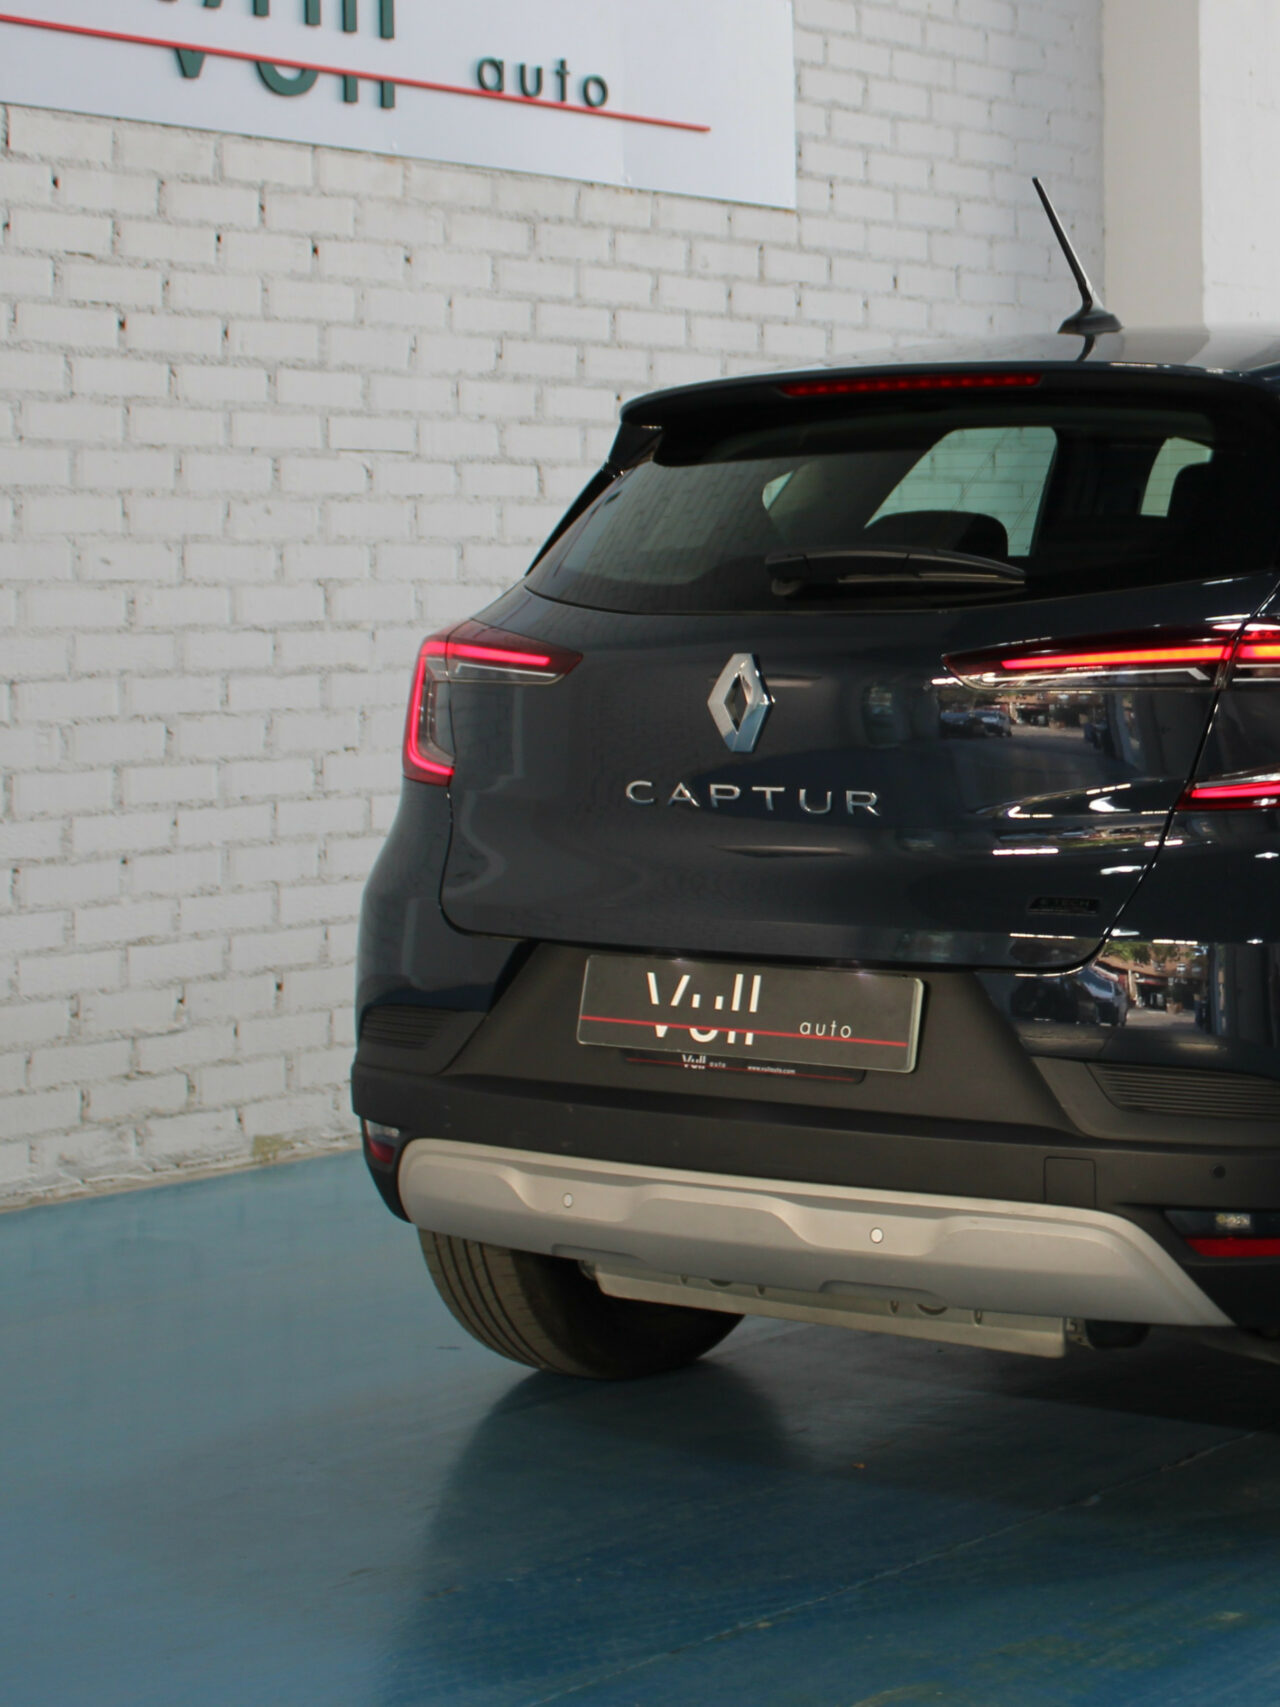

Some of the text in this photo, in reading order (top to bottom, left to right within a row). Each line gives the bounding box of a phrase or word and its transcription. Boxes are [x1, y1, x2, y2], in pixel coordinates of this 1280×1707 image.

[477, 58, 609, 108] auto
[625, 780, 881, 816] CAPTUR
[799, 1020, 852, 1039] auto
